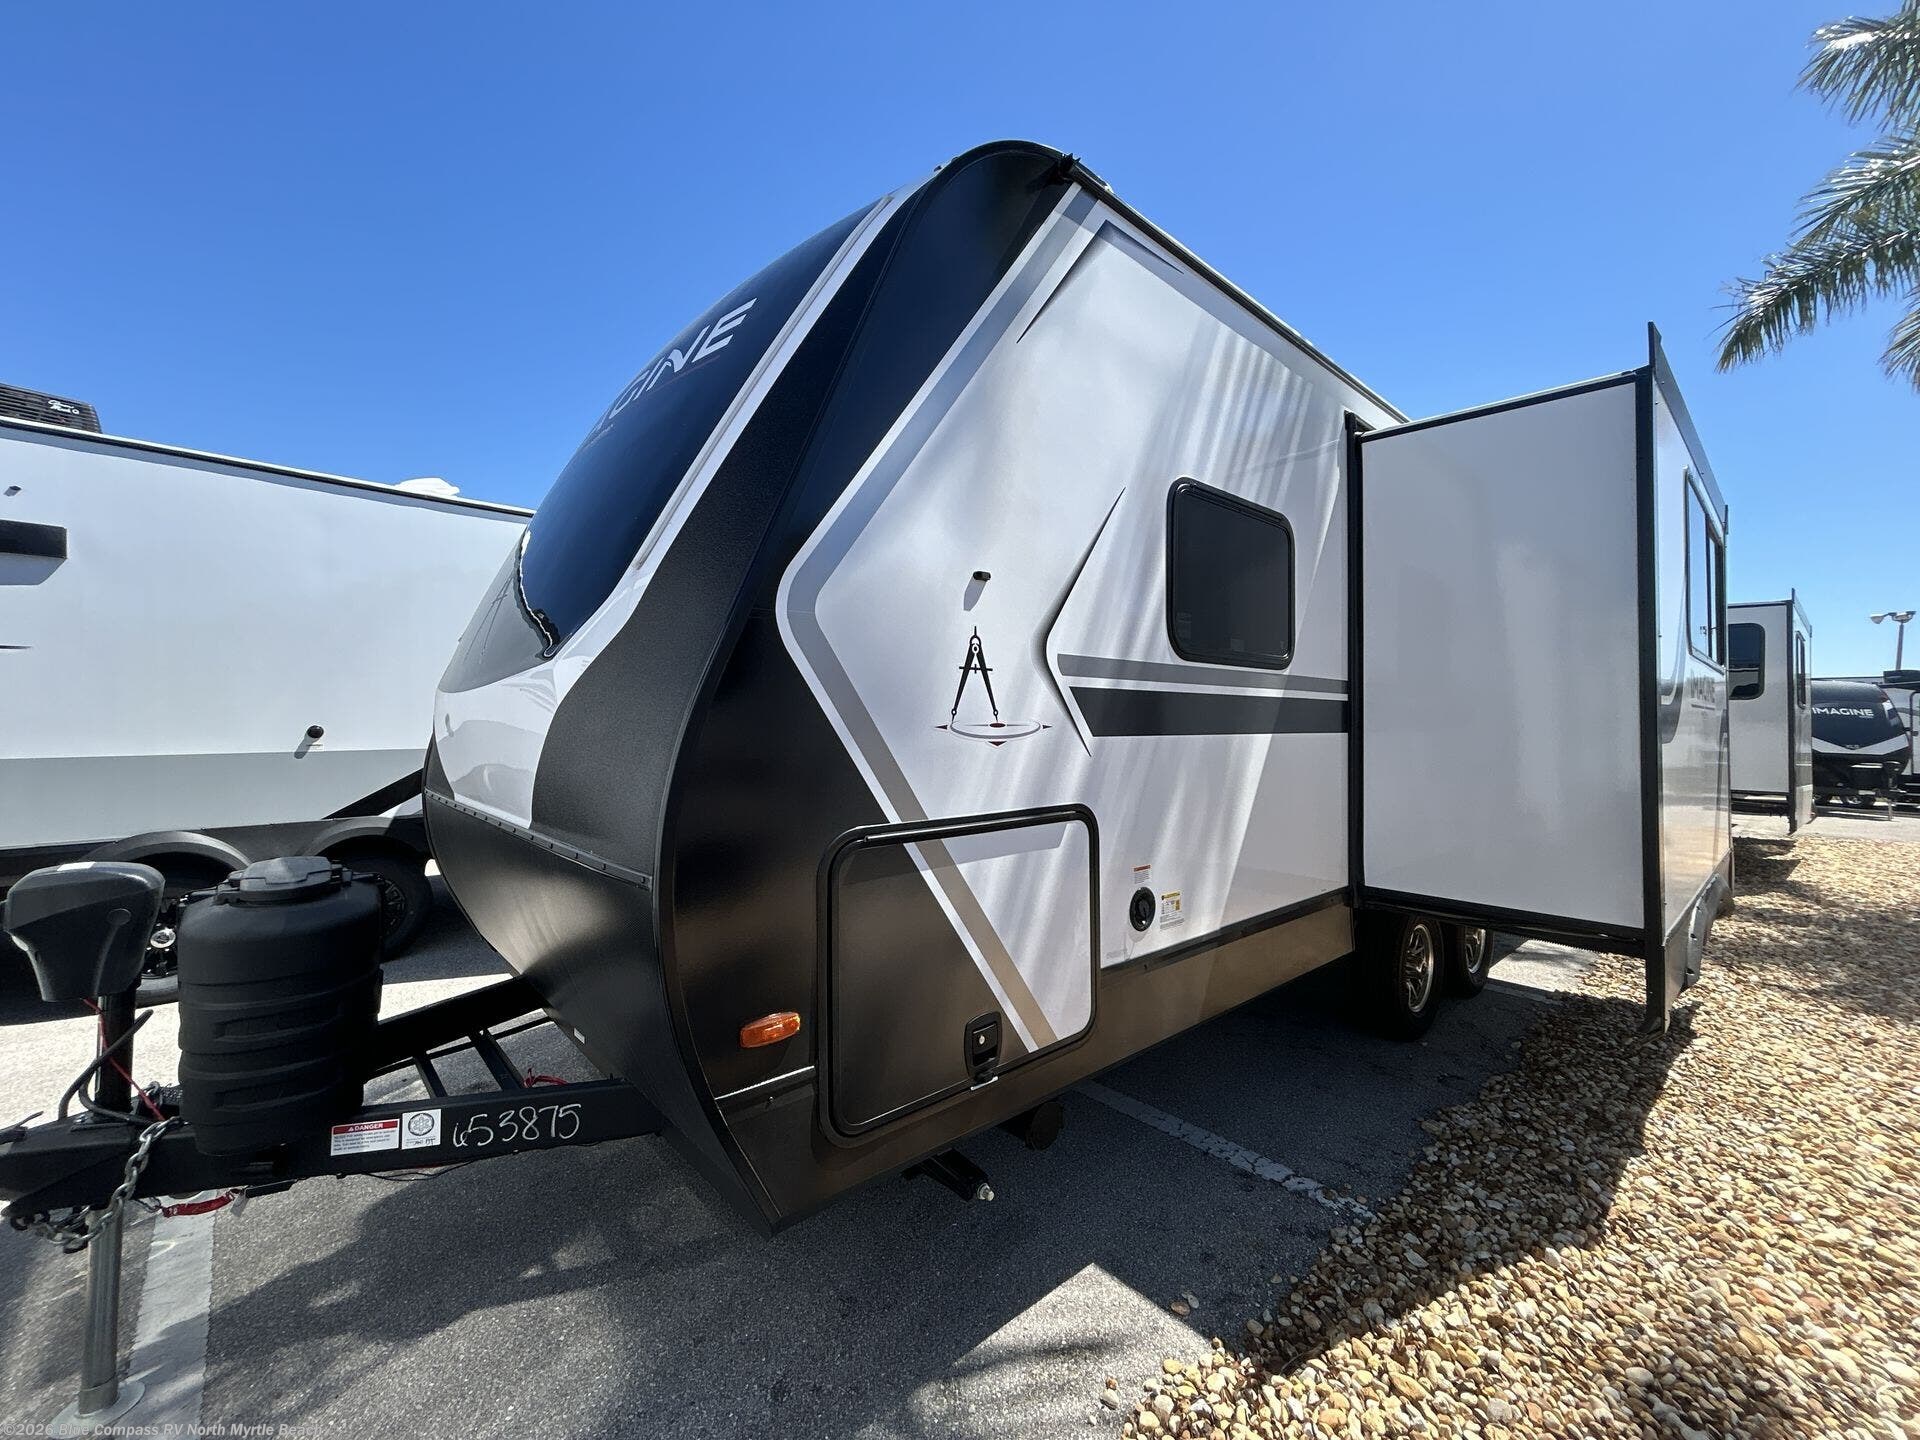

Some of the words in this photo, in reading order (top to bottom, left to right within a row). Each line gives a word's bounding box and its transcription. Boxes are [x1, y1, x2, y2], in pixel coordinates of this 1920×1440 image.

[1811, 707, 1874, 716] IMAGINE
[354, 1122, 384, 1132] DANGER
[453, 1103, 582, 1148] 653875
